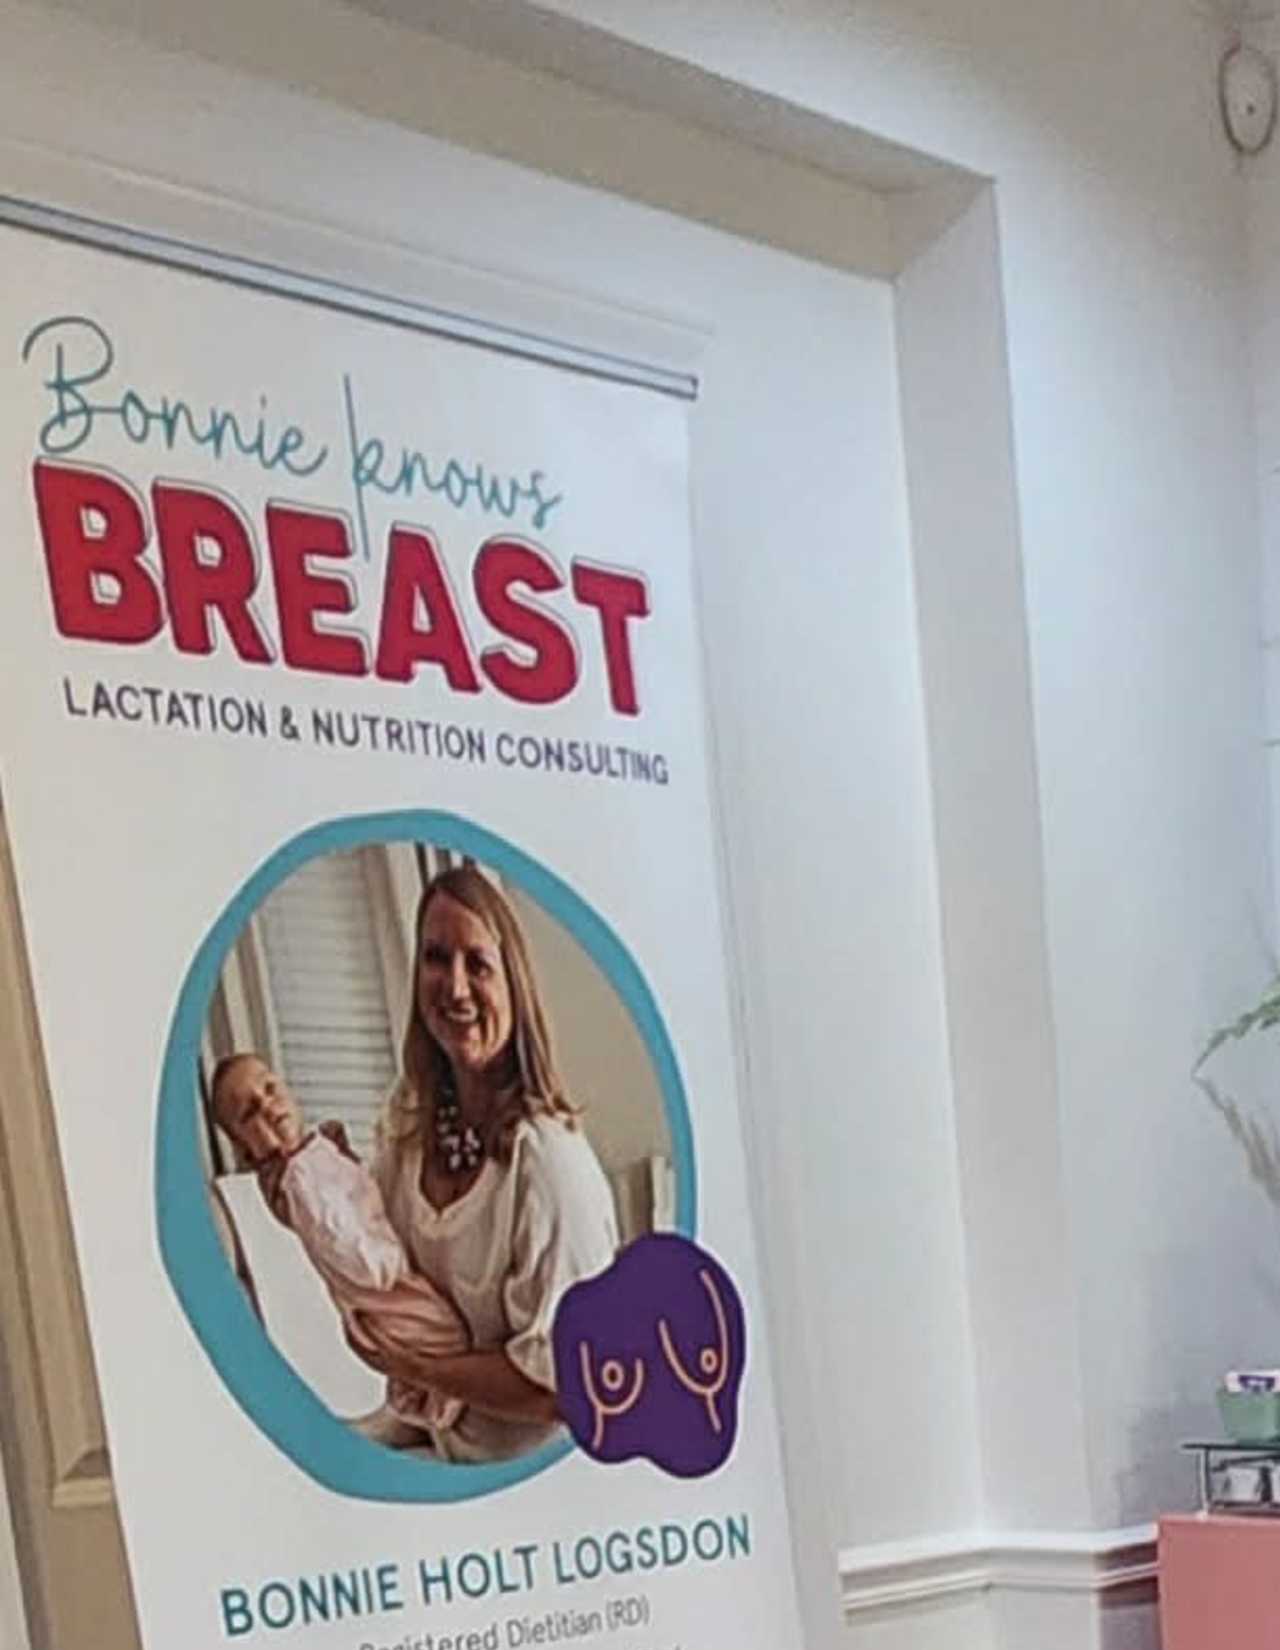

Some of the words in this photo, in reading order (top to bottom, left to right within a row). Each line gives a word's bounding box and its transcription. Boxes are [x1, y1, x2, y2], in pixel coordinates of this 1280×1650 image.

[22, 316, 328, 476] Bonnie
[344, 374, 563, 562] knows
[33, 457, 651, 717] BREAST
[63, 677, 268, 737] LACTATION
[280, 707, 299, 741] &
[312, 708, 486, 765] NUTRITION
[496, 734, 670, 786] CONSULTING
[220, 1564, 405, 1637] BONNIE
[420, 1545, 538, 1604] HOLT
[553, 1514, 752, 1584] LOGSDON
[508, 1606, 601, 1650] Dietitian
[606, 1597, 651, 1631] (RD)
